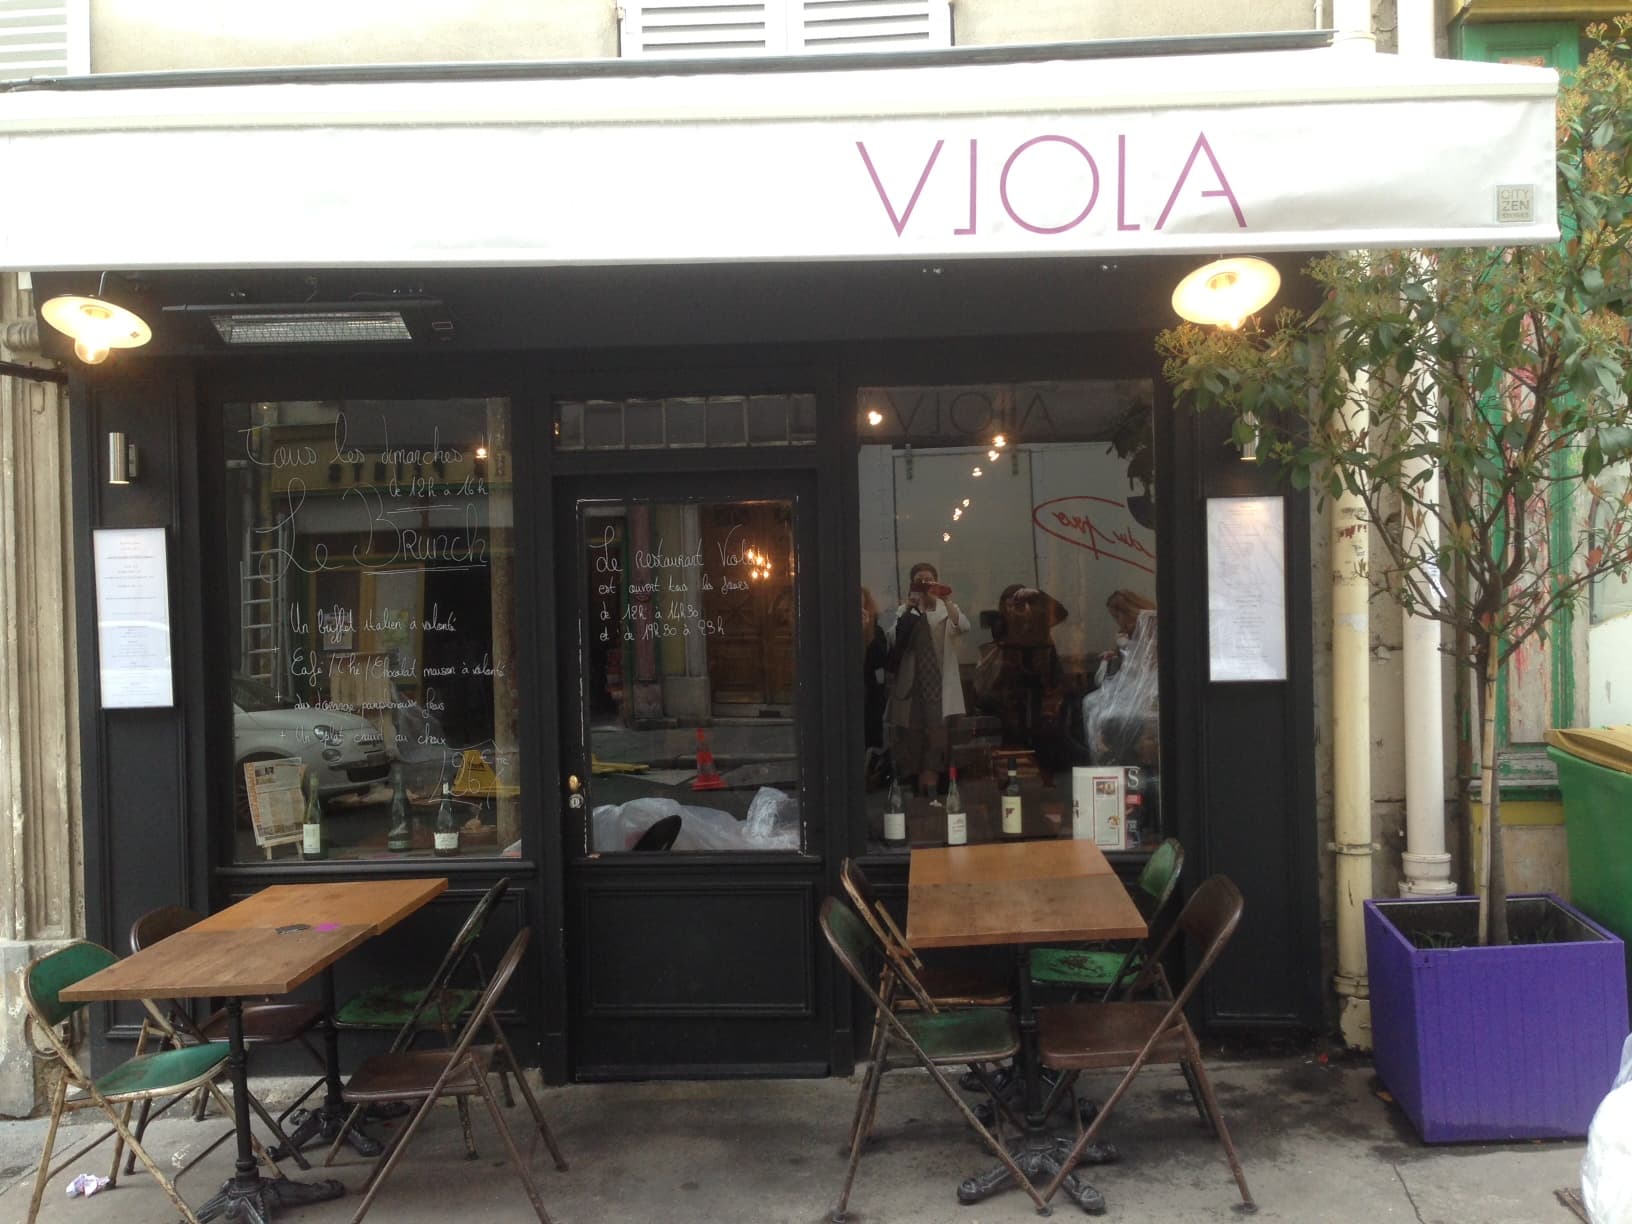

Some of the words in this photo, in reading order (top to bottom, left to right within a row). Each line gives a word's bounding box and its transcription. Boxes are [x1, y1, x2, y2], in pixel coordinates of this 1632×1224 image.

[855, 130, 1248, 238] VIOLA
[1501, 189, 1529, 200] CITY
[1502, 200, 1529, 211] ZEN
[238, 423, 318, 468] Tous
[331, 412, 366, 465] les
[255, 477, 346, 584] Le
[589, 525, 624, 574] Le
[598, 576, 616, 594] est
[290, 602, 310, 634] Un
[316, 603, 356, 644] buffet
[362, 607, 402, 632] italien
[599, 600, 611, 621] de
